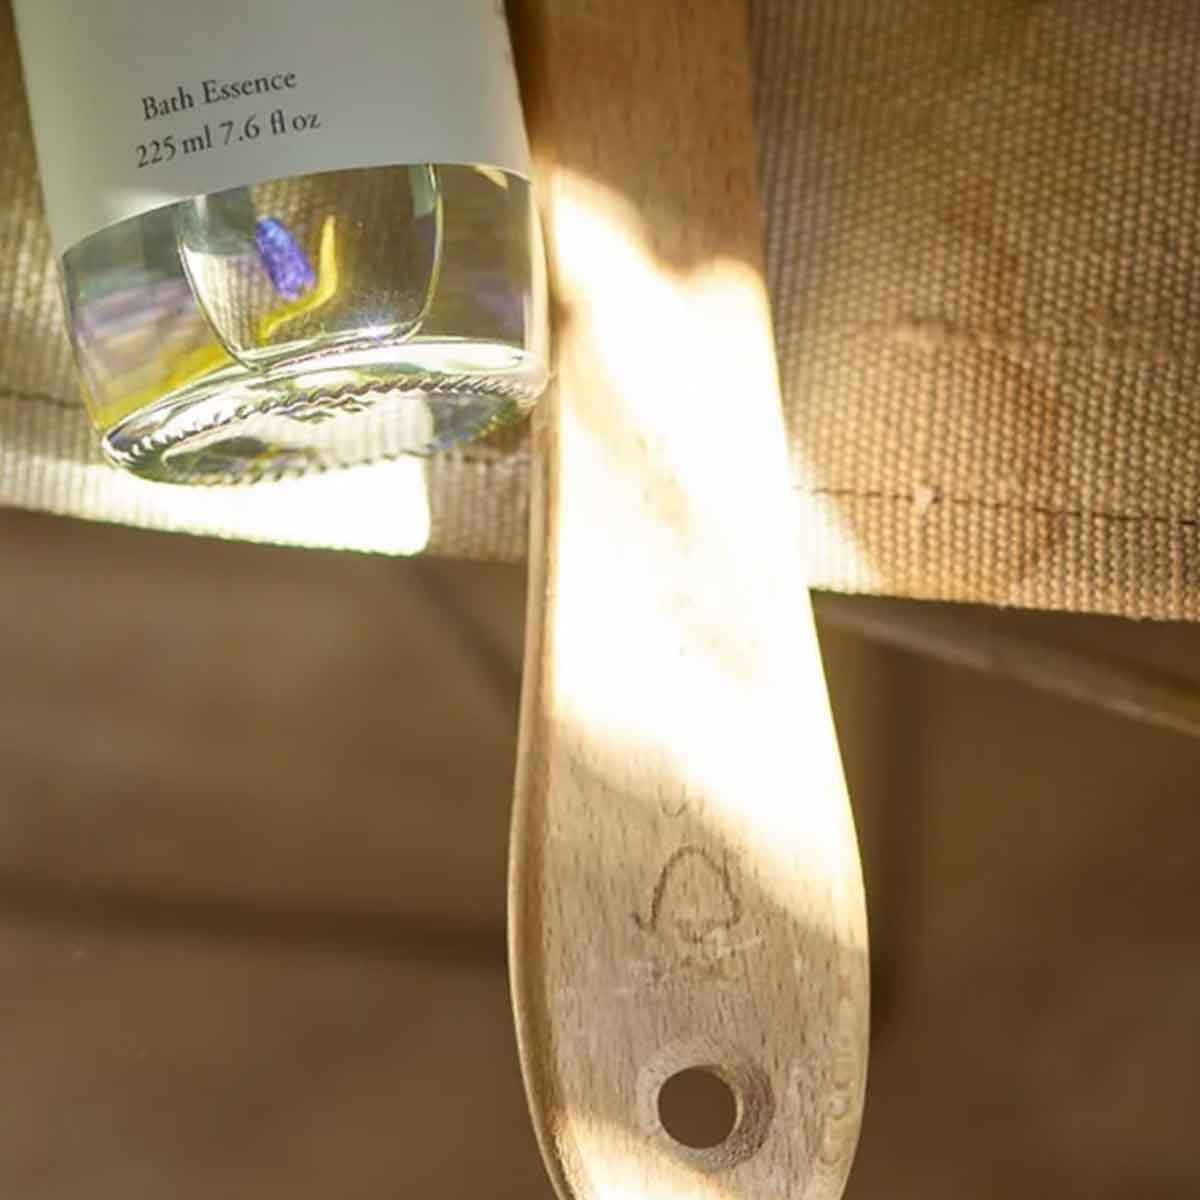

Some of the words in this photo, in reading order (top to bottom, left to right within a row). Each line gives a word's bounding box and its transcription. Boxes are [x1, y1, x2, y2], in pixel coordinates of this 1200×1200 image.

[141, 86, 194, 121] Bath
[201, 71, 297, 104] Essence
[135, 135, 177, 168] 225
[182, 124, 213, 154] ml
[218, 113, 261, 146] 7.6
[269, 108, 287, 135] fl
[292, 112, 322, 132] oz
